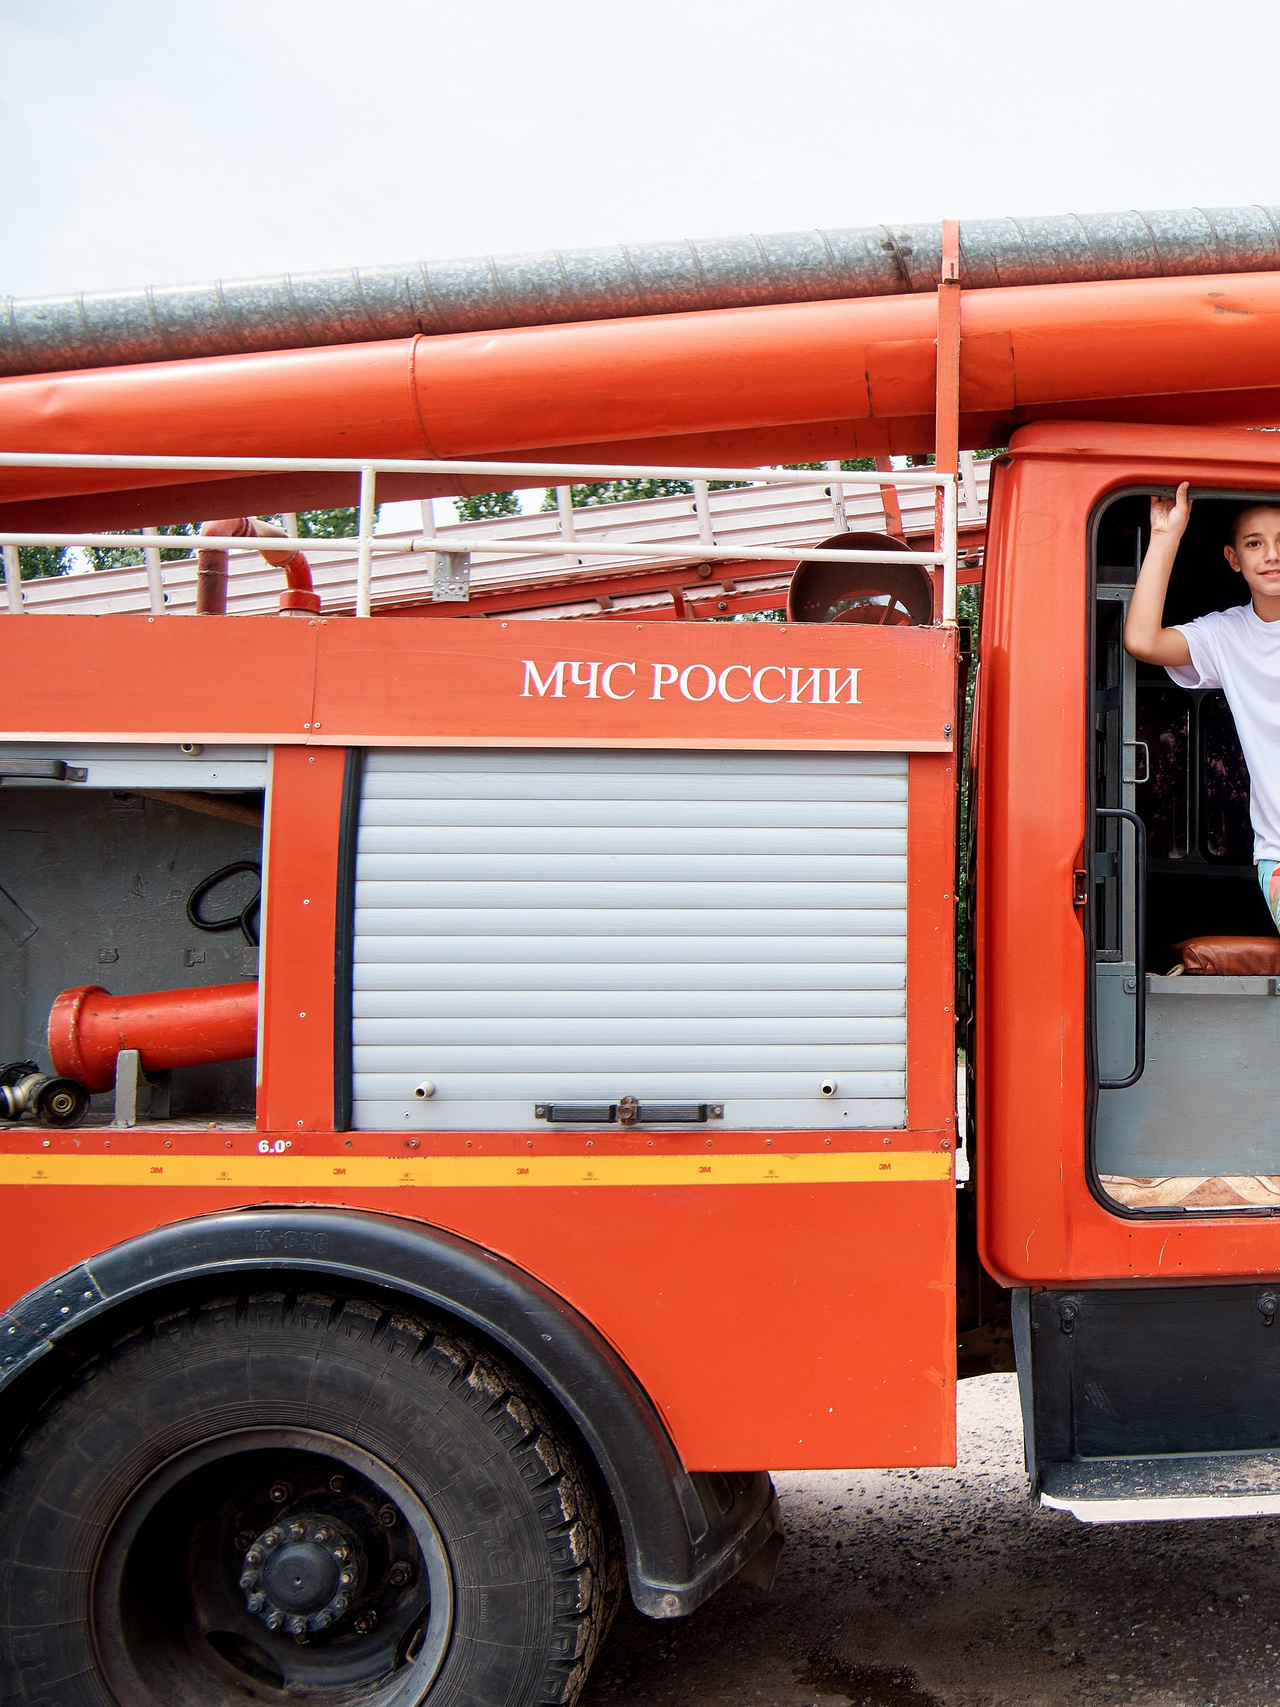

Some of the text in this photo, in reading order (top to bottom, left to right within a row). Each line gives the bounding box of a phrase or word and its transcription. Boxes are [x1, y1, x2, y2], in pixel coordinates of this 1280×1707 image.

[519, 660, 863, 704] МЧС РОССИИ
[150, 1166, 163, 1174] 3M
[699, 1166, 711, 1174] 3M
[879, 1163, 891, 1171] 3M
